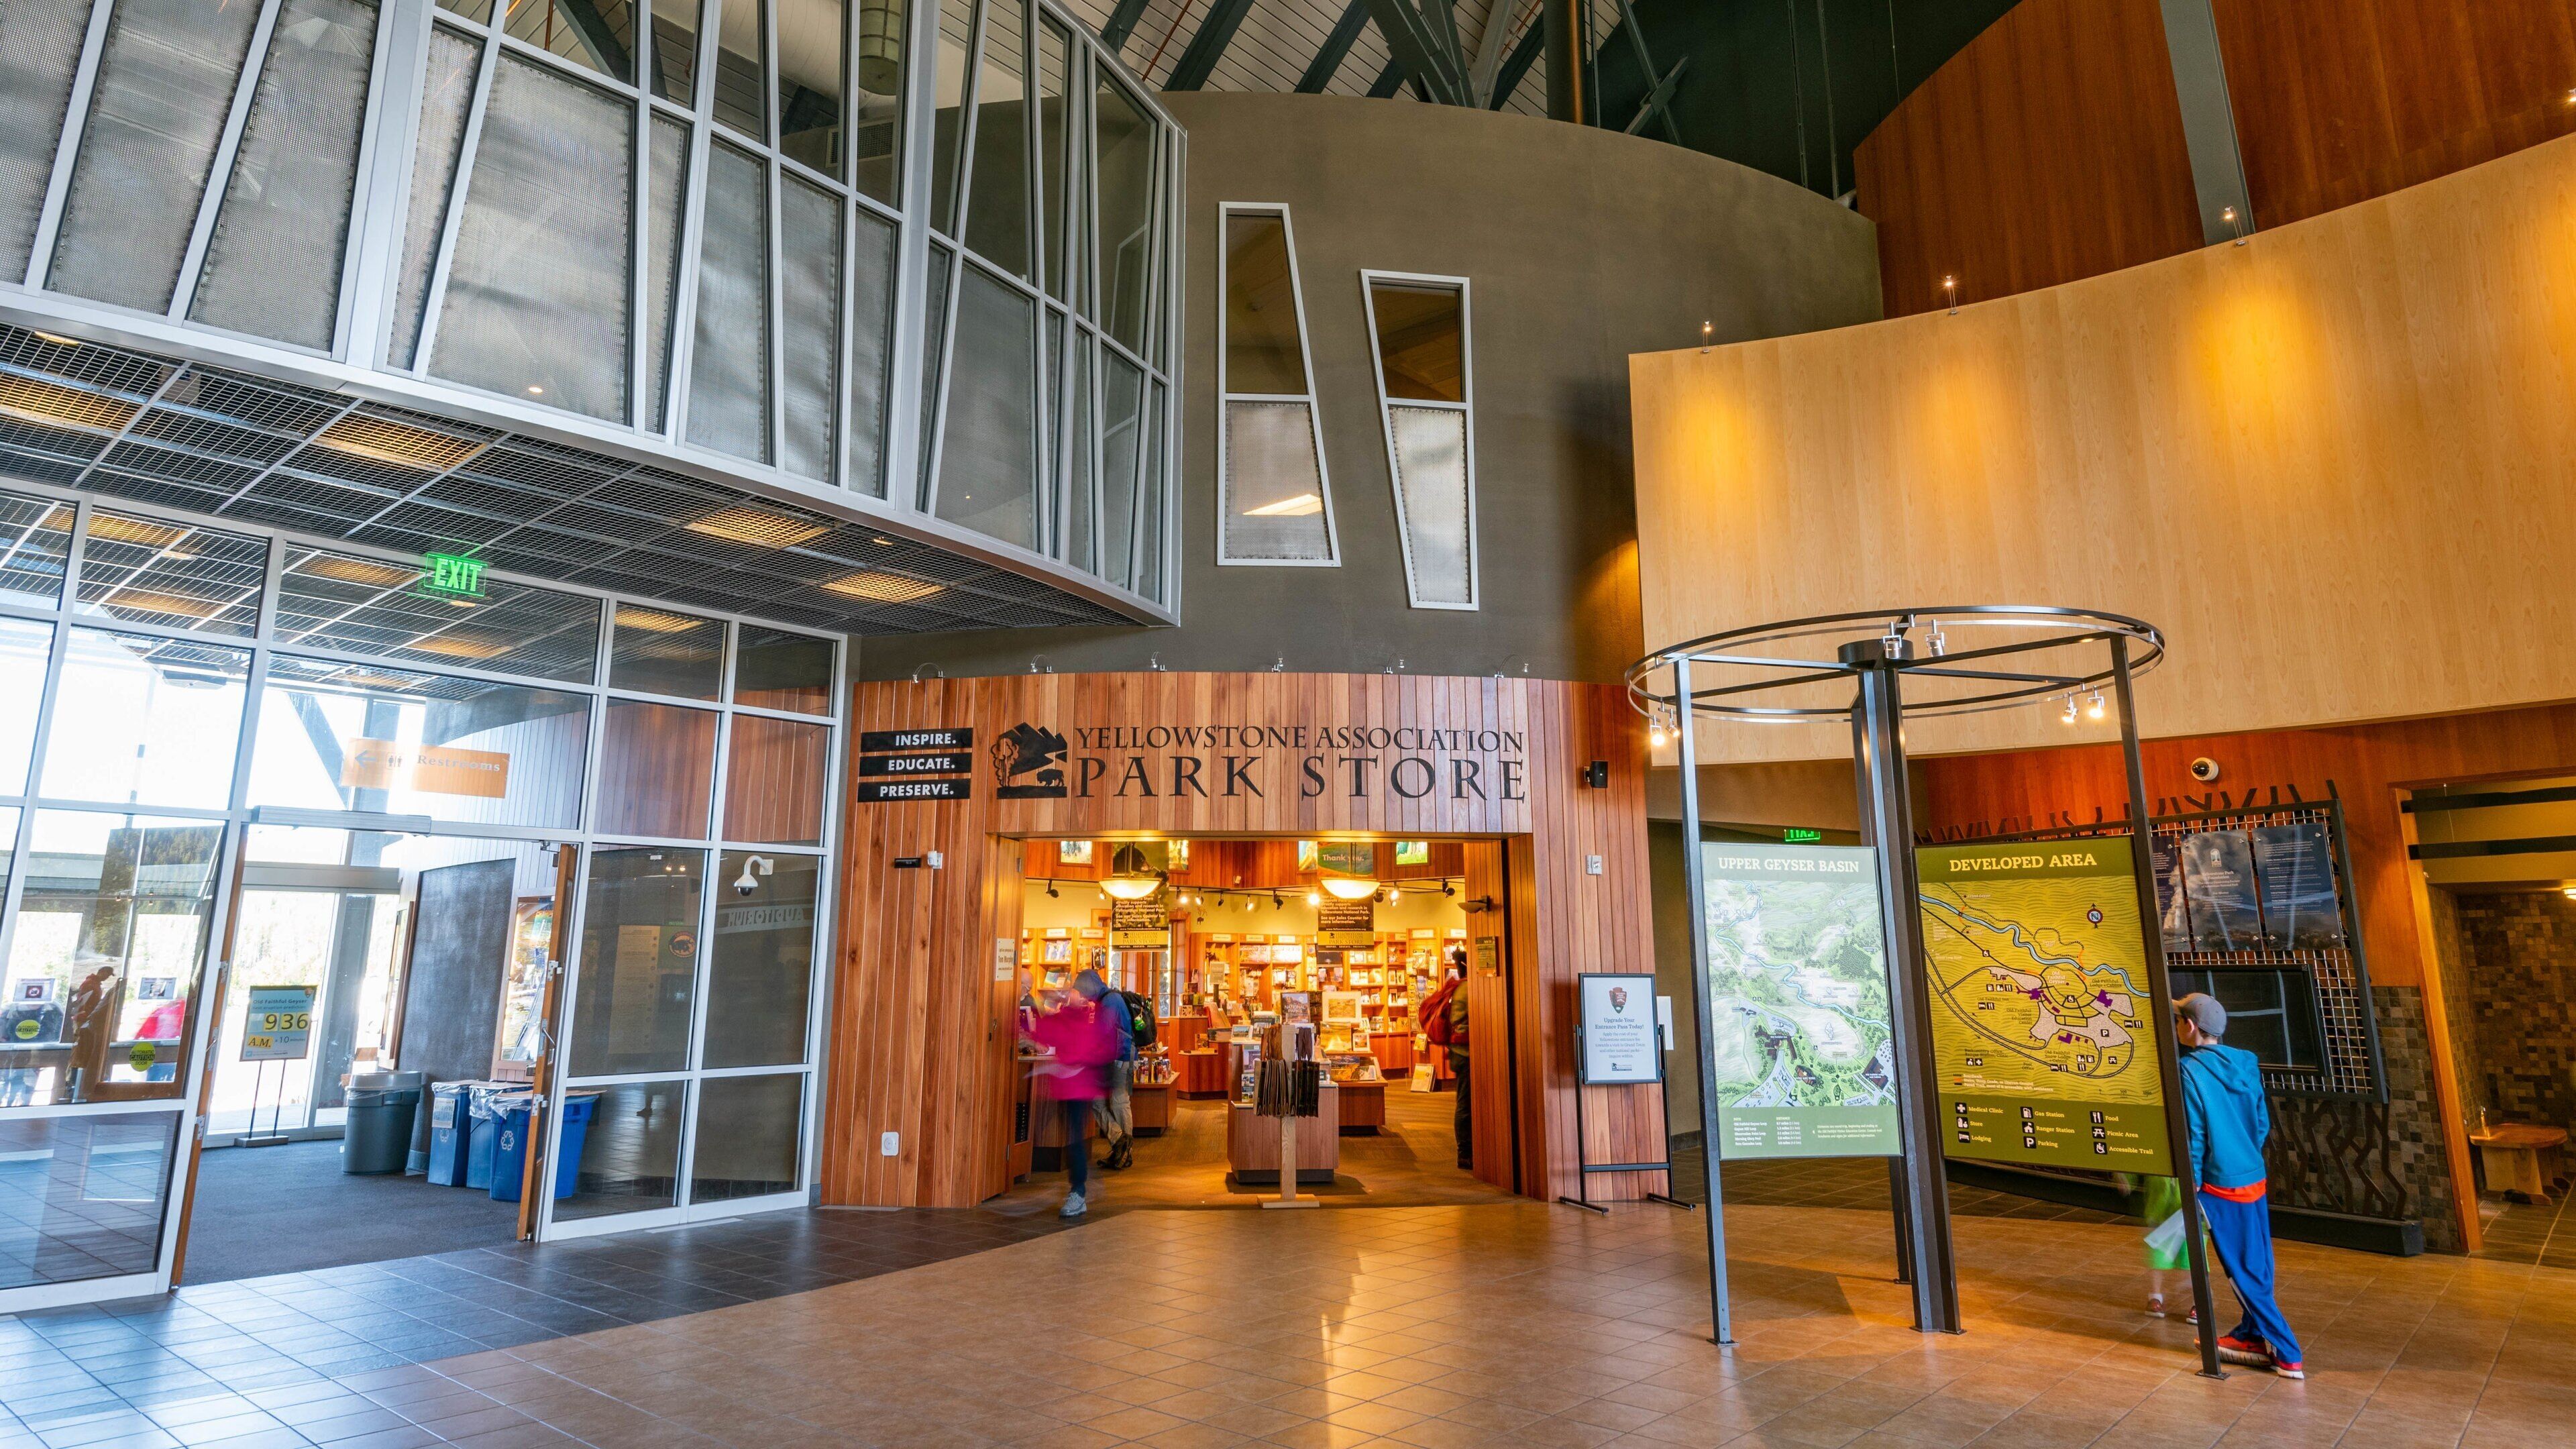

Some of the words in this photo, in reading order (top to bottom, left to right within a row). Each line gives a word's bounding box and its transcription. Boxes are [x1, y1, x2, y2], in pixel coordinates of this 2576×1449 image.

[435, 558, 482, 591] EXIT
[896, 733, 957, 746] INSPIRE.
[1075, 725, 1307, 750] YELLOWSTONE
[1315, 725, 1523, 753] ASSOCIATION
[417, 755, 500, 772] Restrooms
[888, 758, 955, 771] EDUCATE.
[1075, 756, 1264, 798] PARK
[1301, 753, 1525, 804] STORE
[879, 784, 954, 797] PRESERVE.
[1718, 857, 1761, 869] UPPER
[1764, 859, 1815, 871] GEYSER
[1818, 860, 1859, 873] BASIN
[1950, 855, 2044, 871] DEVELOPED
[2049, 853, 2097, 867] AREA
[265, 1014, 309, 1030] 936
[248, 1038, 271, 1048] A.M.
[2037, 1140, 2059, 1148] Parking
[2109, 1146, 2138, 1154] Accessible
